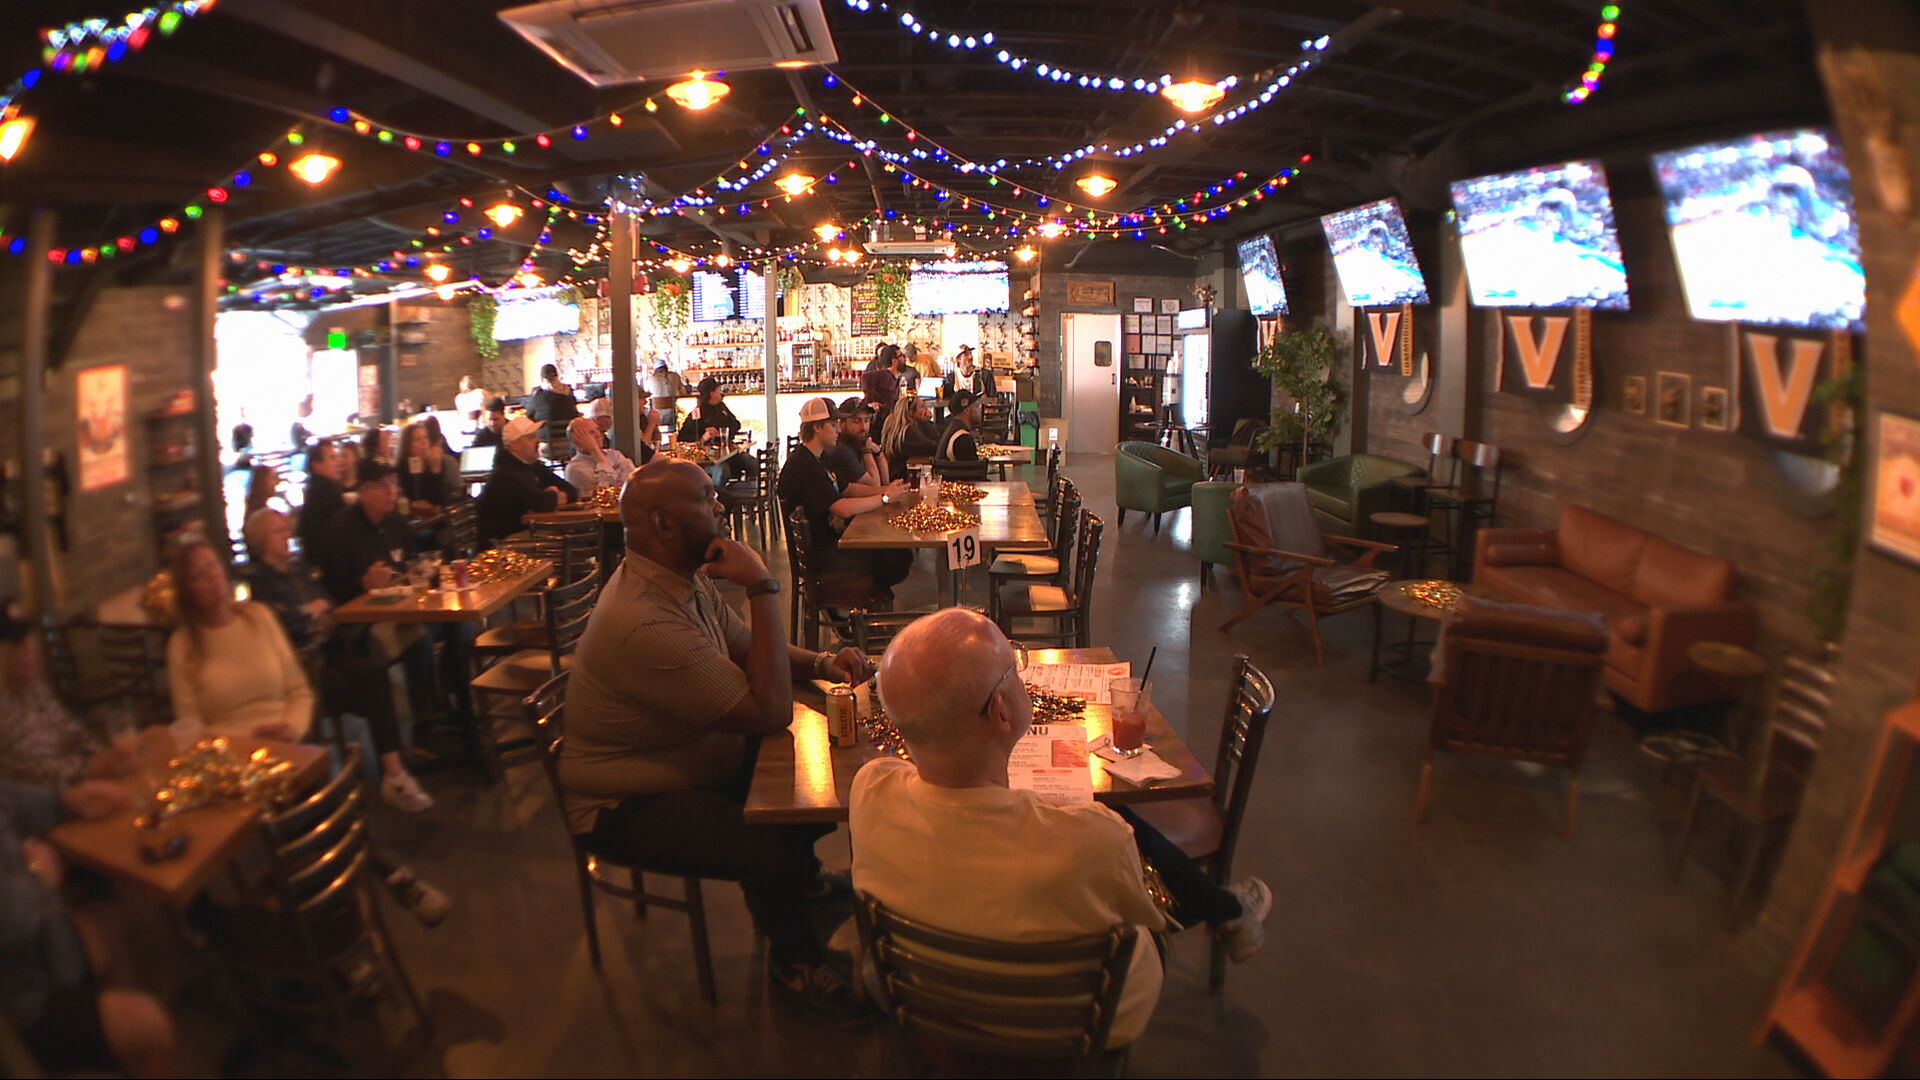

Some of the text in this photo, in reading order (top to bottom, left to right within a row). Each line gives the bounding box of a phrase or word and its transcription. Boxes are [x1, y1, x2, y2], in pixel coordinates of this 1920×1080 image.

[1368, 312, 1401, 366] V
[1506, 316, 1570, 388] V
[1746, 332, 1825, 438] V
[952, 535, 975, 561] 19
[1027, 726, 1048, 736] NU
